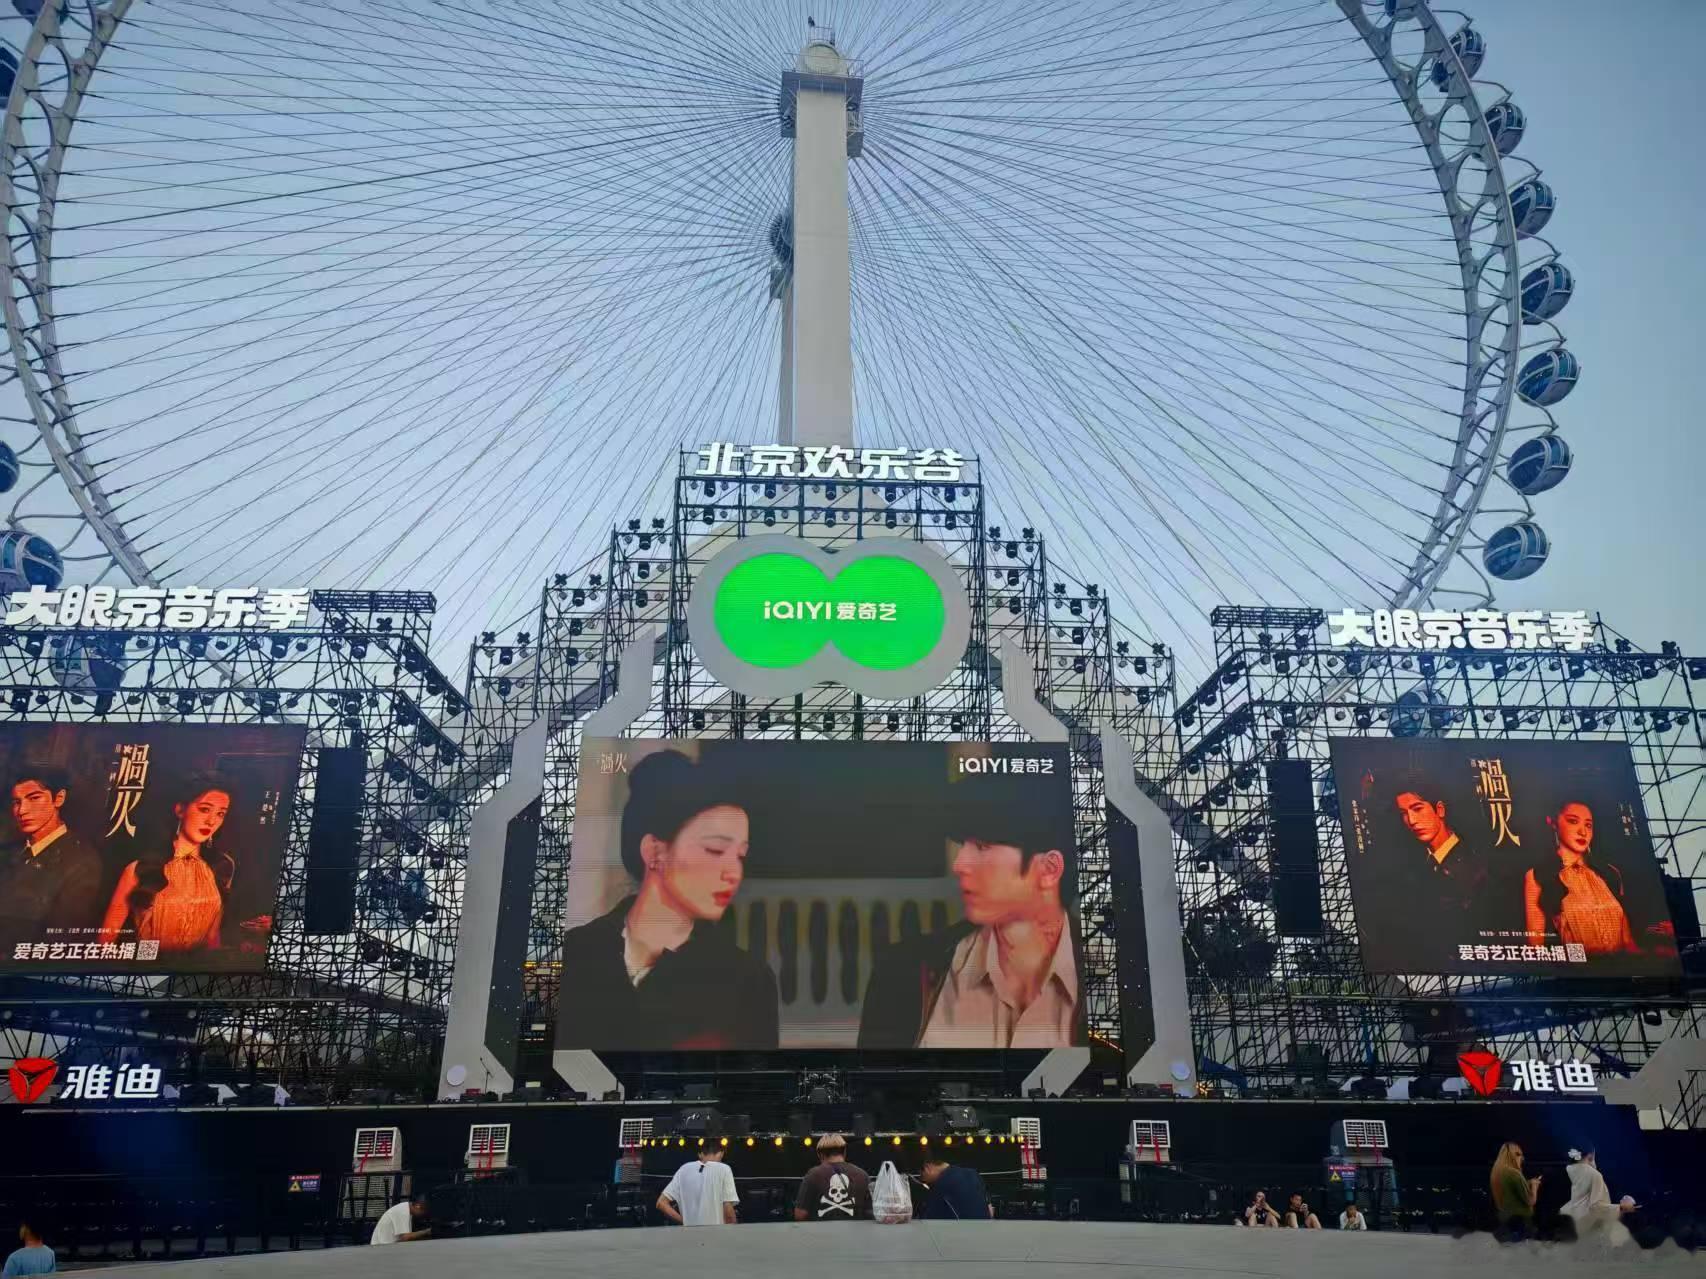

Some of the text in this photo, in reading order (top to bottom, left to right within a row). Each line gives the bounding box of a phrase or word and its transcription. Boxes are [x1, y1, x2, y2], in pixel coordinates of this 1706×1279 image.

[696, 442, 966, 481] 北京欢乐谷
[5, 585, 310, 629] 大眼京音乐季
[763, 601, 898, 622] iQIYI 爱奇艺
[1327, 608, 1596, 651] 大眼京音乐季
[958, 757, 1055, 774] iQIYI 爱奇艺
[13, 941, 137, 960] 爱奇艺正在热播
[1458, 944, 1567, 962] 爱奇艺正在热播
[60, 1063, 161, 1098] 雅迪
[1510, 1058, 1598, 1092] 雅迪
